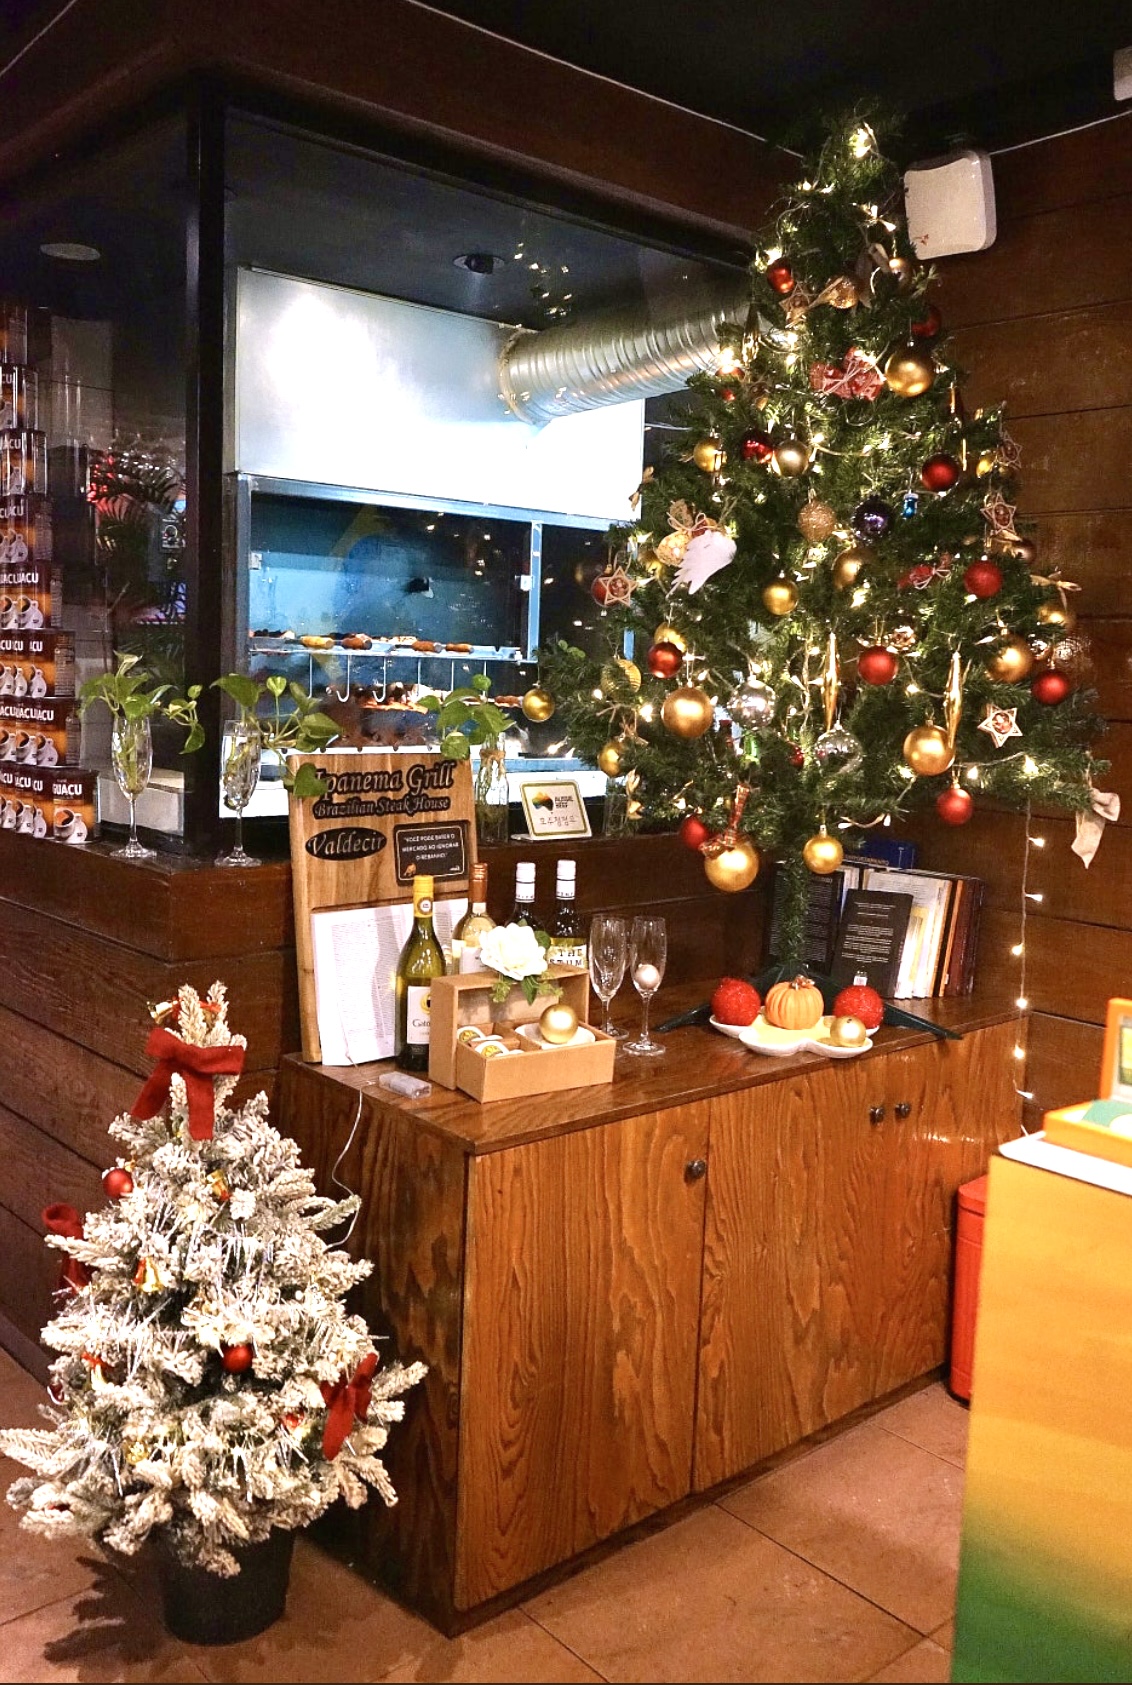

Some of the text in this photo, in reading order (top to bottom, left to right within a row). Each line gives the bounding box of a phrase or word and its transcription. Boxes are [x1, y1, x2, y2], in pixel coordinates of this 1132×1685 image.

[408, 763, 455, 795] Grill
[315, 796, 448, 817] Brazilian Steak House
[308, 831, 385, 855] Valdecir
